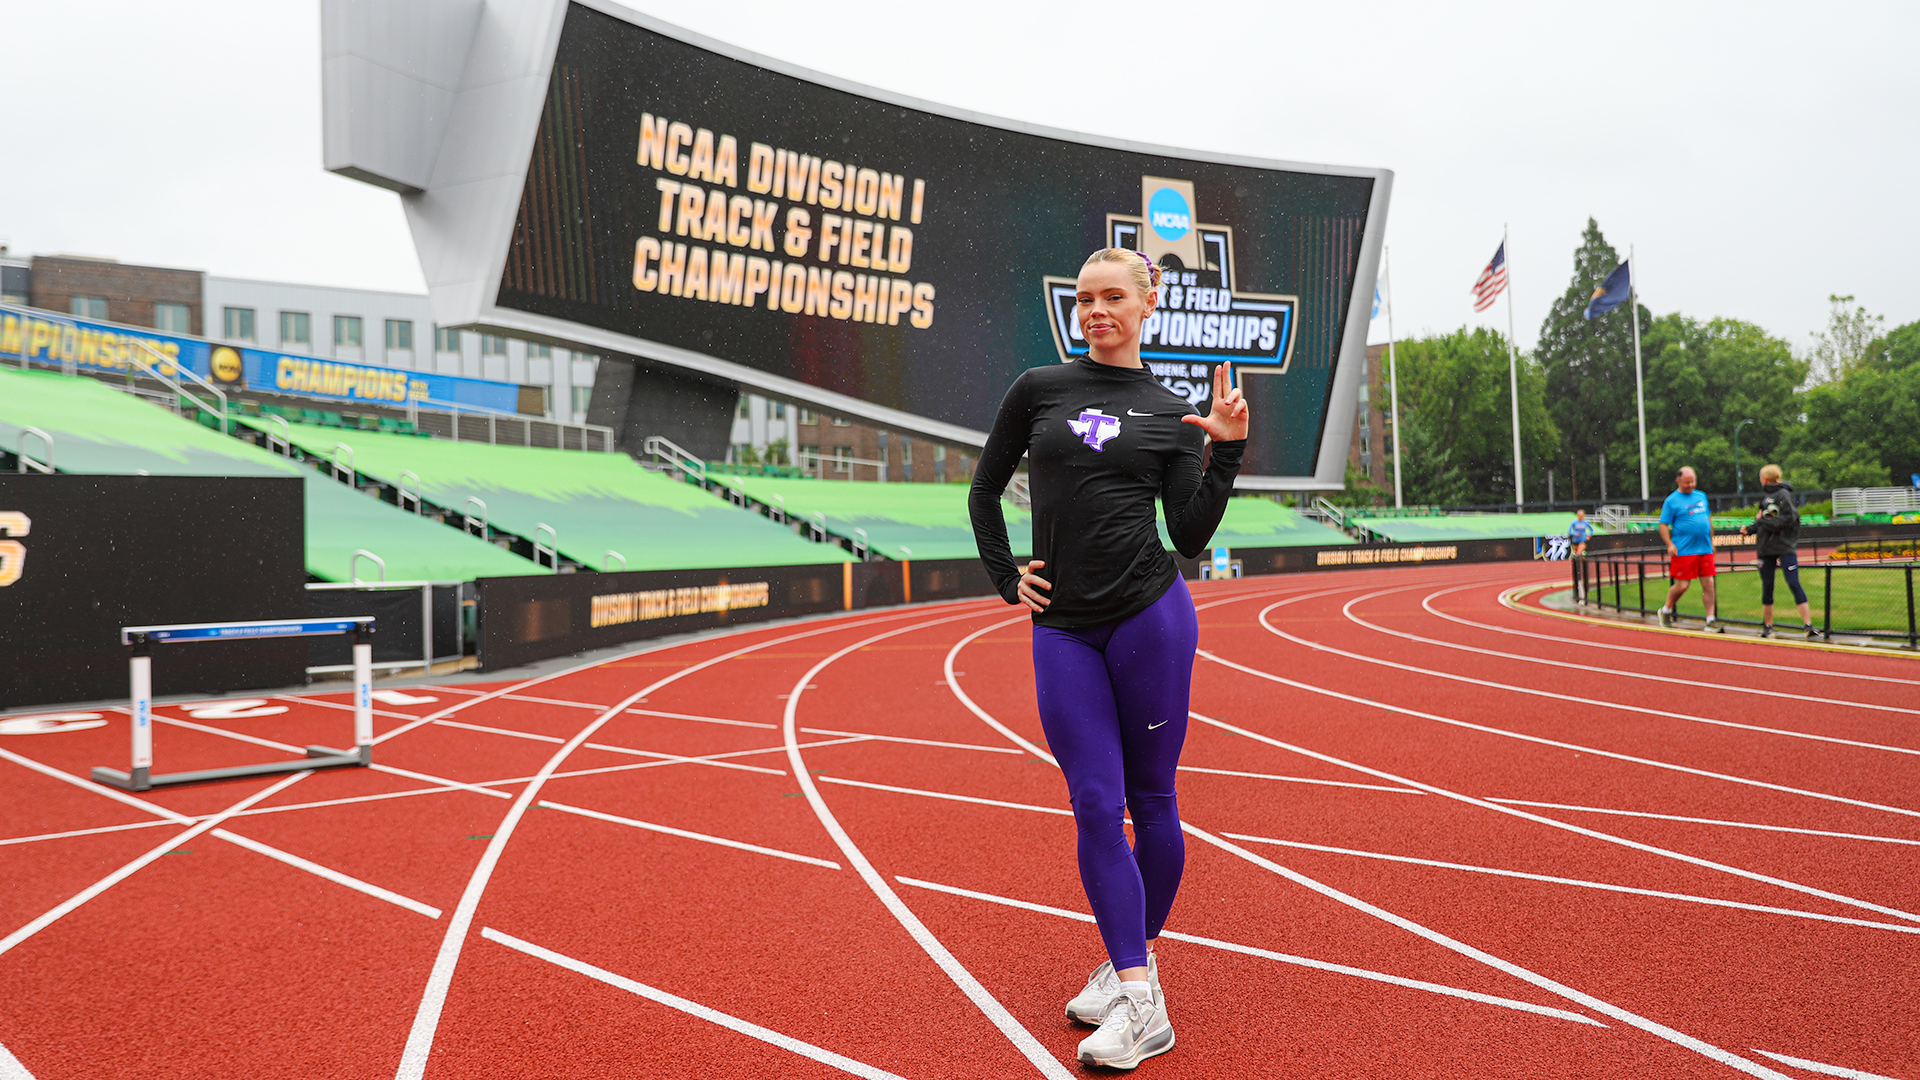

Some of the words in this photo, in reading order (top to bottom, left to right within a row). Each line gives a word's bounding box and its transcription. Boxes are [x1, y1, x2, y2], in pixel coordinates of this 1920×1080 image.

[637, 112, 738, 189] NCAA
[747, 141, 904, 221] DIVISION
[910, 178, 926, 225] I
[656, 177, 779, 252] TRACK
[784, 207, 812, 258] &
[818, 213, 914, 274] FIELD
[1152, 211, 1191, 231] NCAA
[632, 235, 936, 330] CHAMPIONSHIPS
[1185, 286, 1231, 312] FIELD
[276, 356, 407, 402] CHAMPIONS
[1191, 364, 1208, 378] OR
[1317, 551, 1347, 566] DIVISION
[1352, 549, 1374, 564] TRACK
[1381, 548, 1399, 562] FIELD
[1400, 546, 1457, 561] CHAMPIONSHIPS
[591, 593, 632, 628] DIVISION
[638, 589, 668, 621] TRACK
[676, 586, 700, 616] FIELD
[700, 581, 769, 613] CHAMPIONSHIPS
